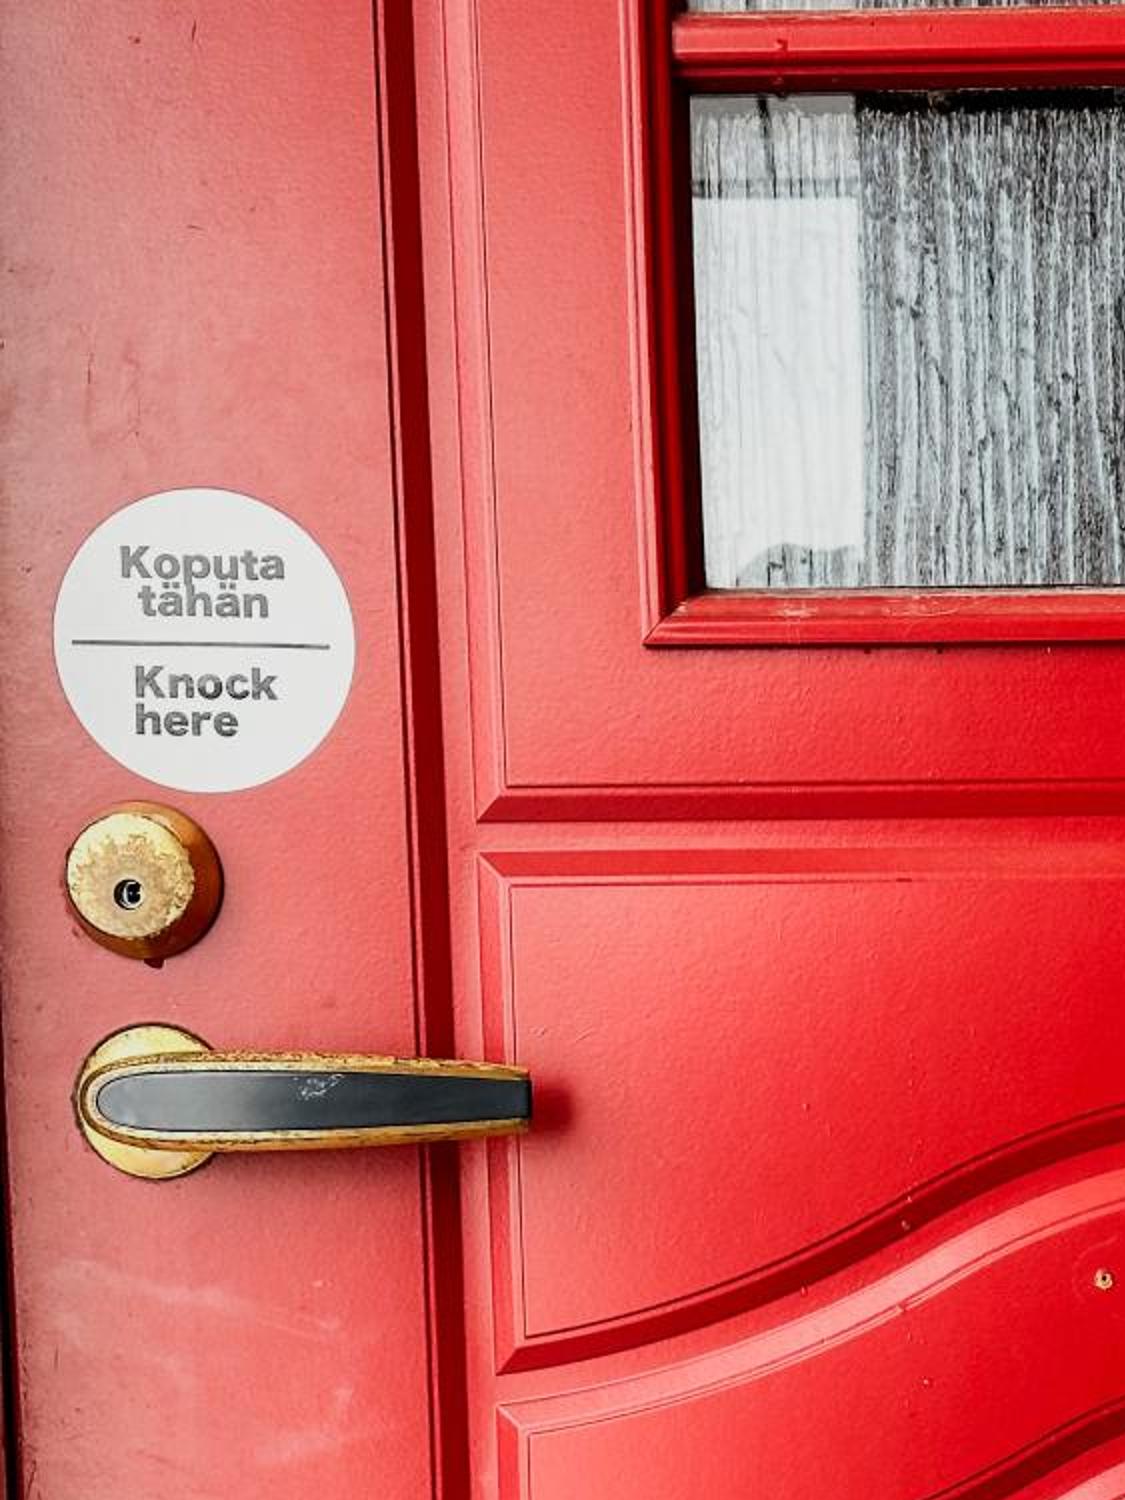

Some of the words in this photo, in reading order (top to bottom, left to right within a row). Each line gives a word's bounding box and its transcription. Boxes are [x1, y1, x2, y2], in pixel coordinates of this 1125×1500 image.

[119, 545, 286, 586] Koputa
[137, 581, 269, 619] tähän
[135, 665, 279, 701] Knock
[135, 703, 239, 738] here
